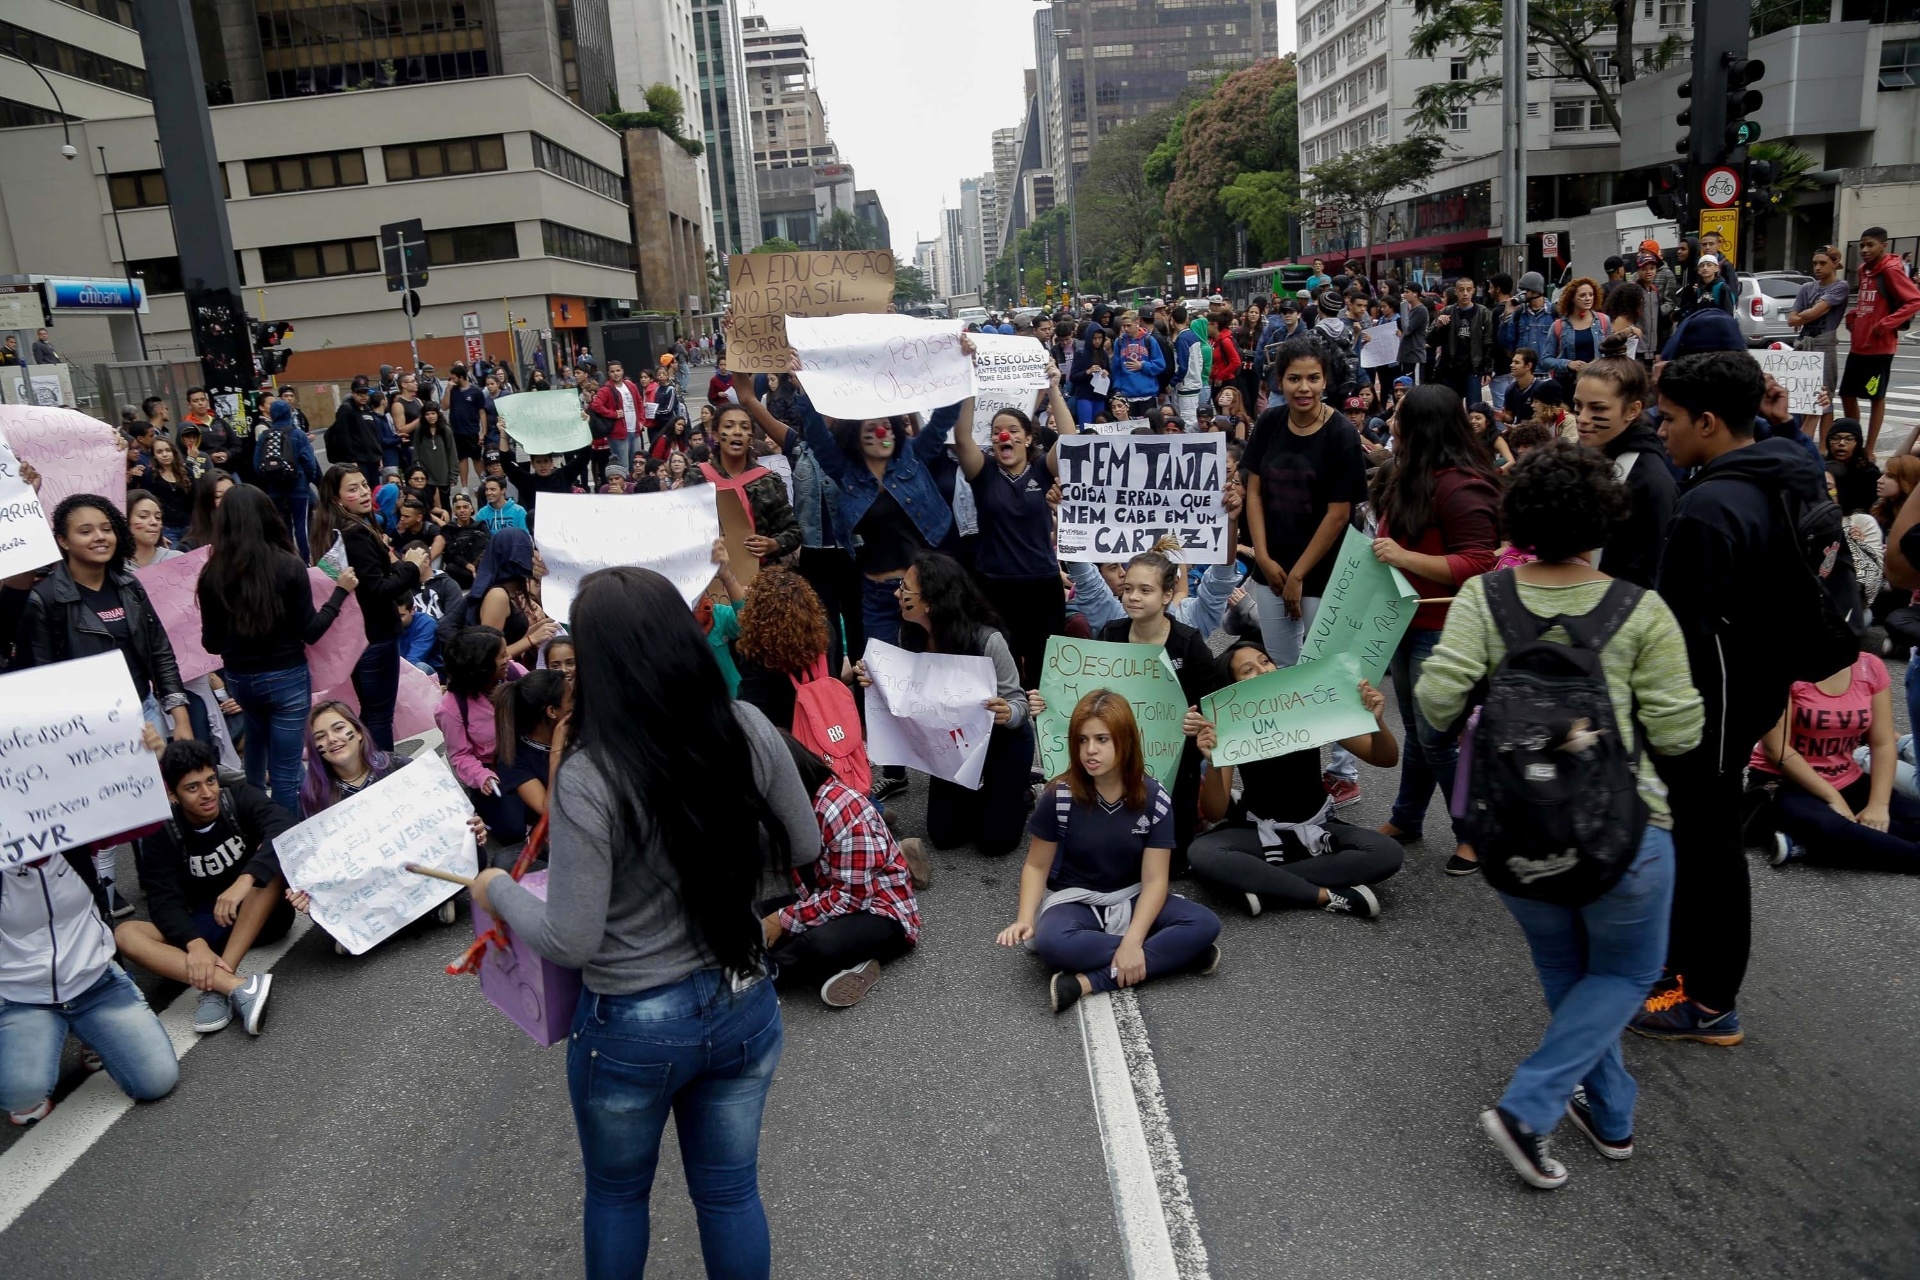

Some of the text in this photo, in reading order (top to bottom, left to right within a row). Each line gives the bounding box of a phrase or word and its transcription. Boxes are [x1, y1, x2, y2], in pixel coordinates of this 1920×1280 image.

[1703, 215, 1736, 223] CICLISTA
[736, 250, 892, 287] A EDUCAÇÃO
[79, 285, 122, 304] citibank
[731, 290, 760, 315] NO
[977, 354, 1045, 366] AS ESCOLAS!
[977, 366, 997, 375] ANTES
[998, 366, 1011, 374] QUE
[1017, 364, 1046, 372] GOVERNO
[1763, 353, 1822, 371] APAGAR
[979, 374, 995, 382] TOME
[1059, 441, 1220, 491] TEM TANTA
[1115, 490, 1170, 507] ERRADA
[1180, 493, 1211, 513] QUE
[1061, 505, 1217, 525] NEM CABE EM UM
[1314, 605, 1341, 653] AULA
[1335, 556, 1361, 601] HOJE
[1345, 616, 1363, 631] É
[1361, 600, 1400, 667] NA RUA
[1050, 642, 1161, 680] DESCULPE
[107, 697, 123, 723] é
[1209, 684, 1340, 725] PROCURA-SE
[1252, 718, 1279, 735] UM
[66, 738, 143, 768] mexeu
[1223, 729, 1310, 762] GOVERNO
[26, 774, 154, 824] mexeu comigo
